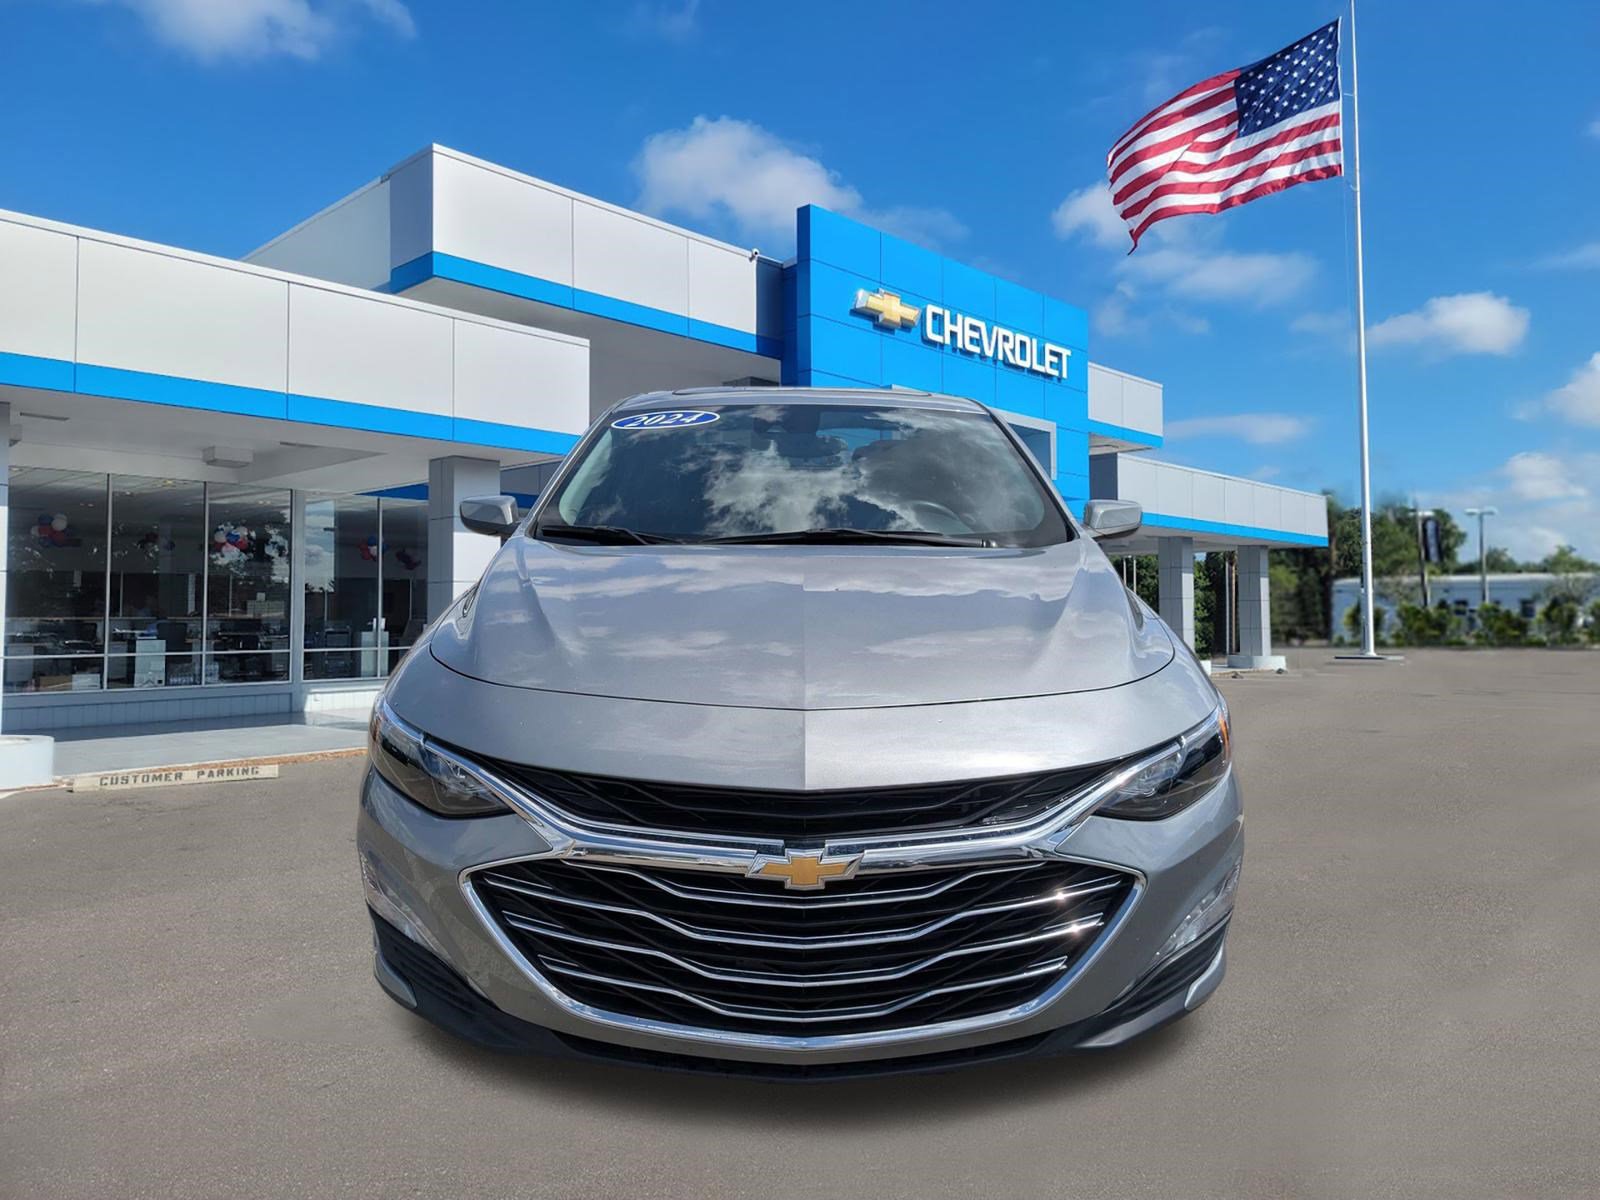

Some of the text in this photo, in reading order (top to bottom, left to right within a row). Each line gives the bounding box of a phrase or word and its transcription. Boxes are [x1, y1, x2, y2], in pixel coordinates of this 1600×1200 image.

[925, 304, 1071, 379] CHEVROLET
[624, 412, 706, 428] 2024
[99, 766, 260, 787] CUSTOMER PARKING
